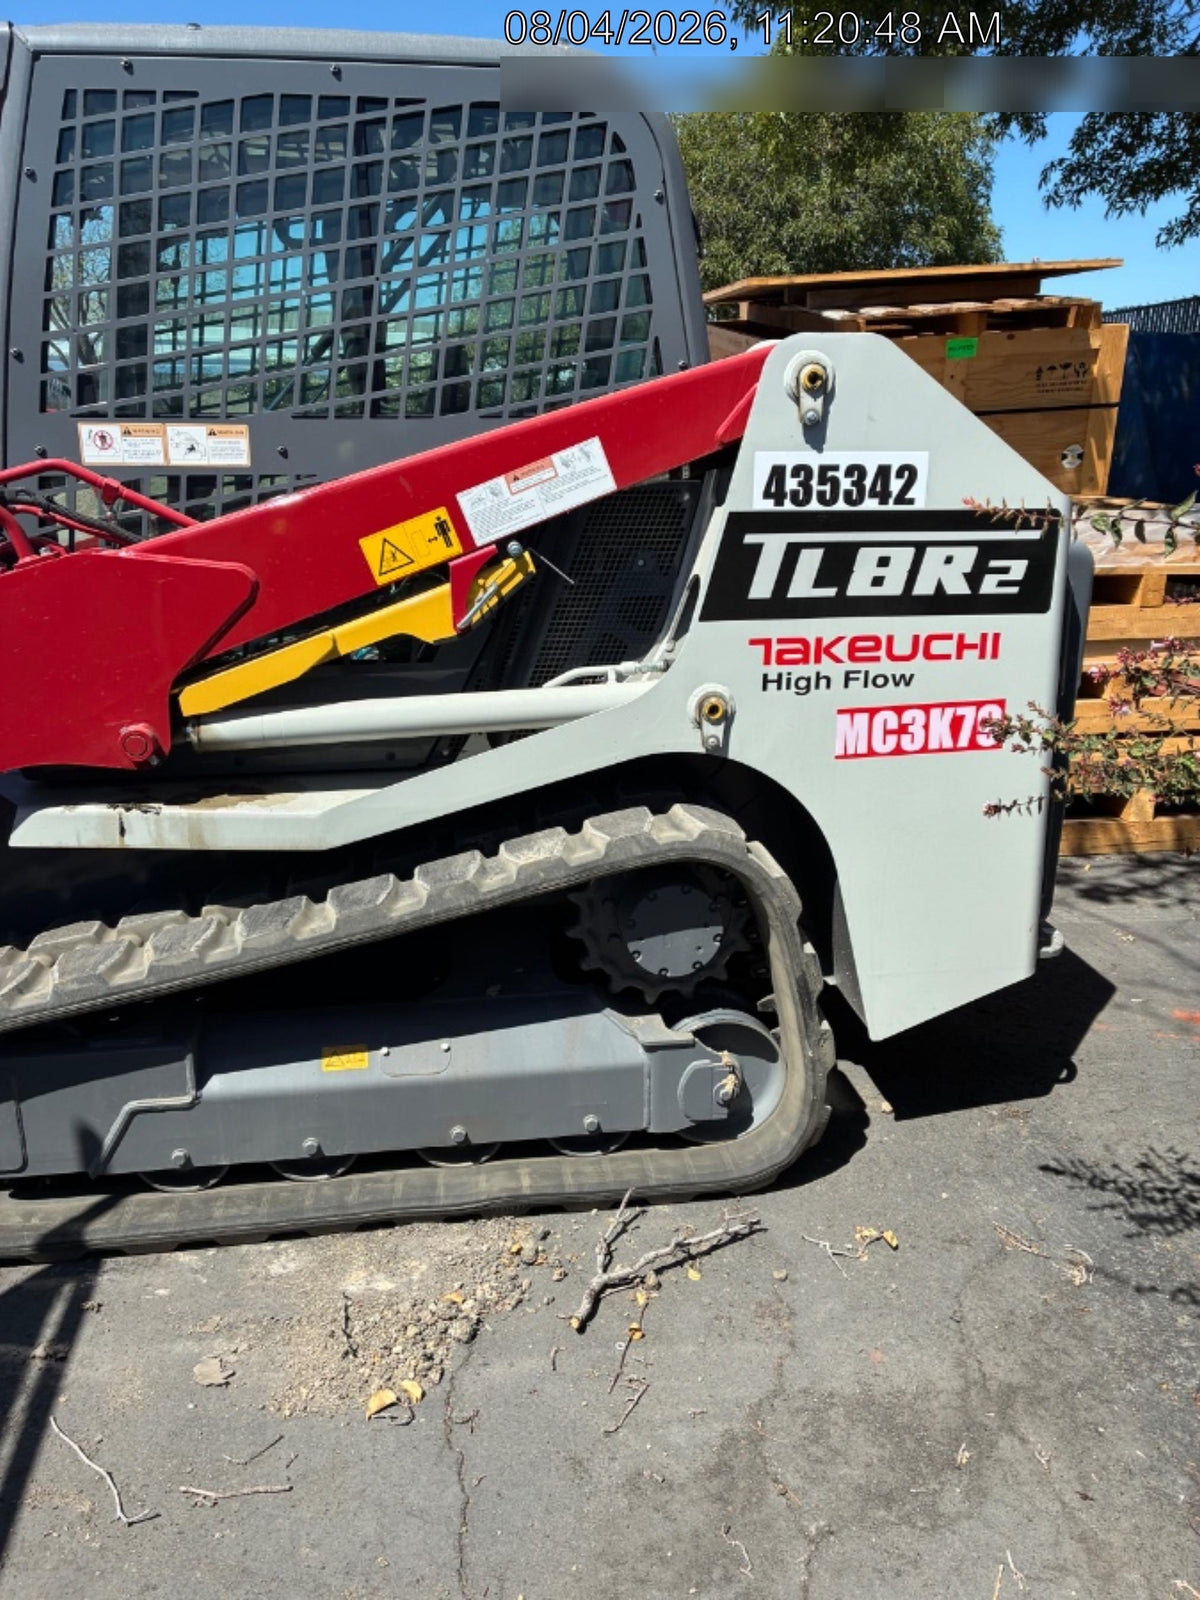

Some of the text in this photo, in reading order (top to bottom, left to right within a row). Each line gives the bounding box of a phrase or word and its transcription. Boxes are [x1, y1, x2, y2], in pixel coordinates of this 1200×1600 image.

[762, 463, 919, 507] 435342
[748, 632, 1001, 666] TAKEUCHI
[761, 669, 915, 696] High Flow
